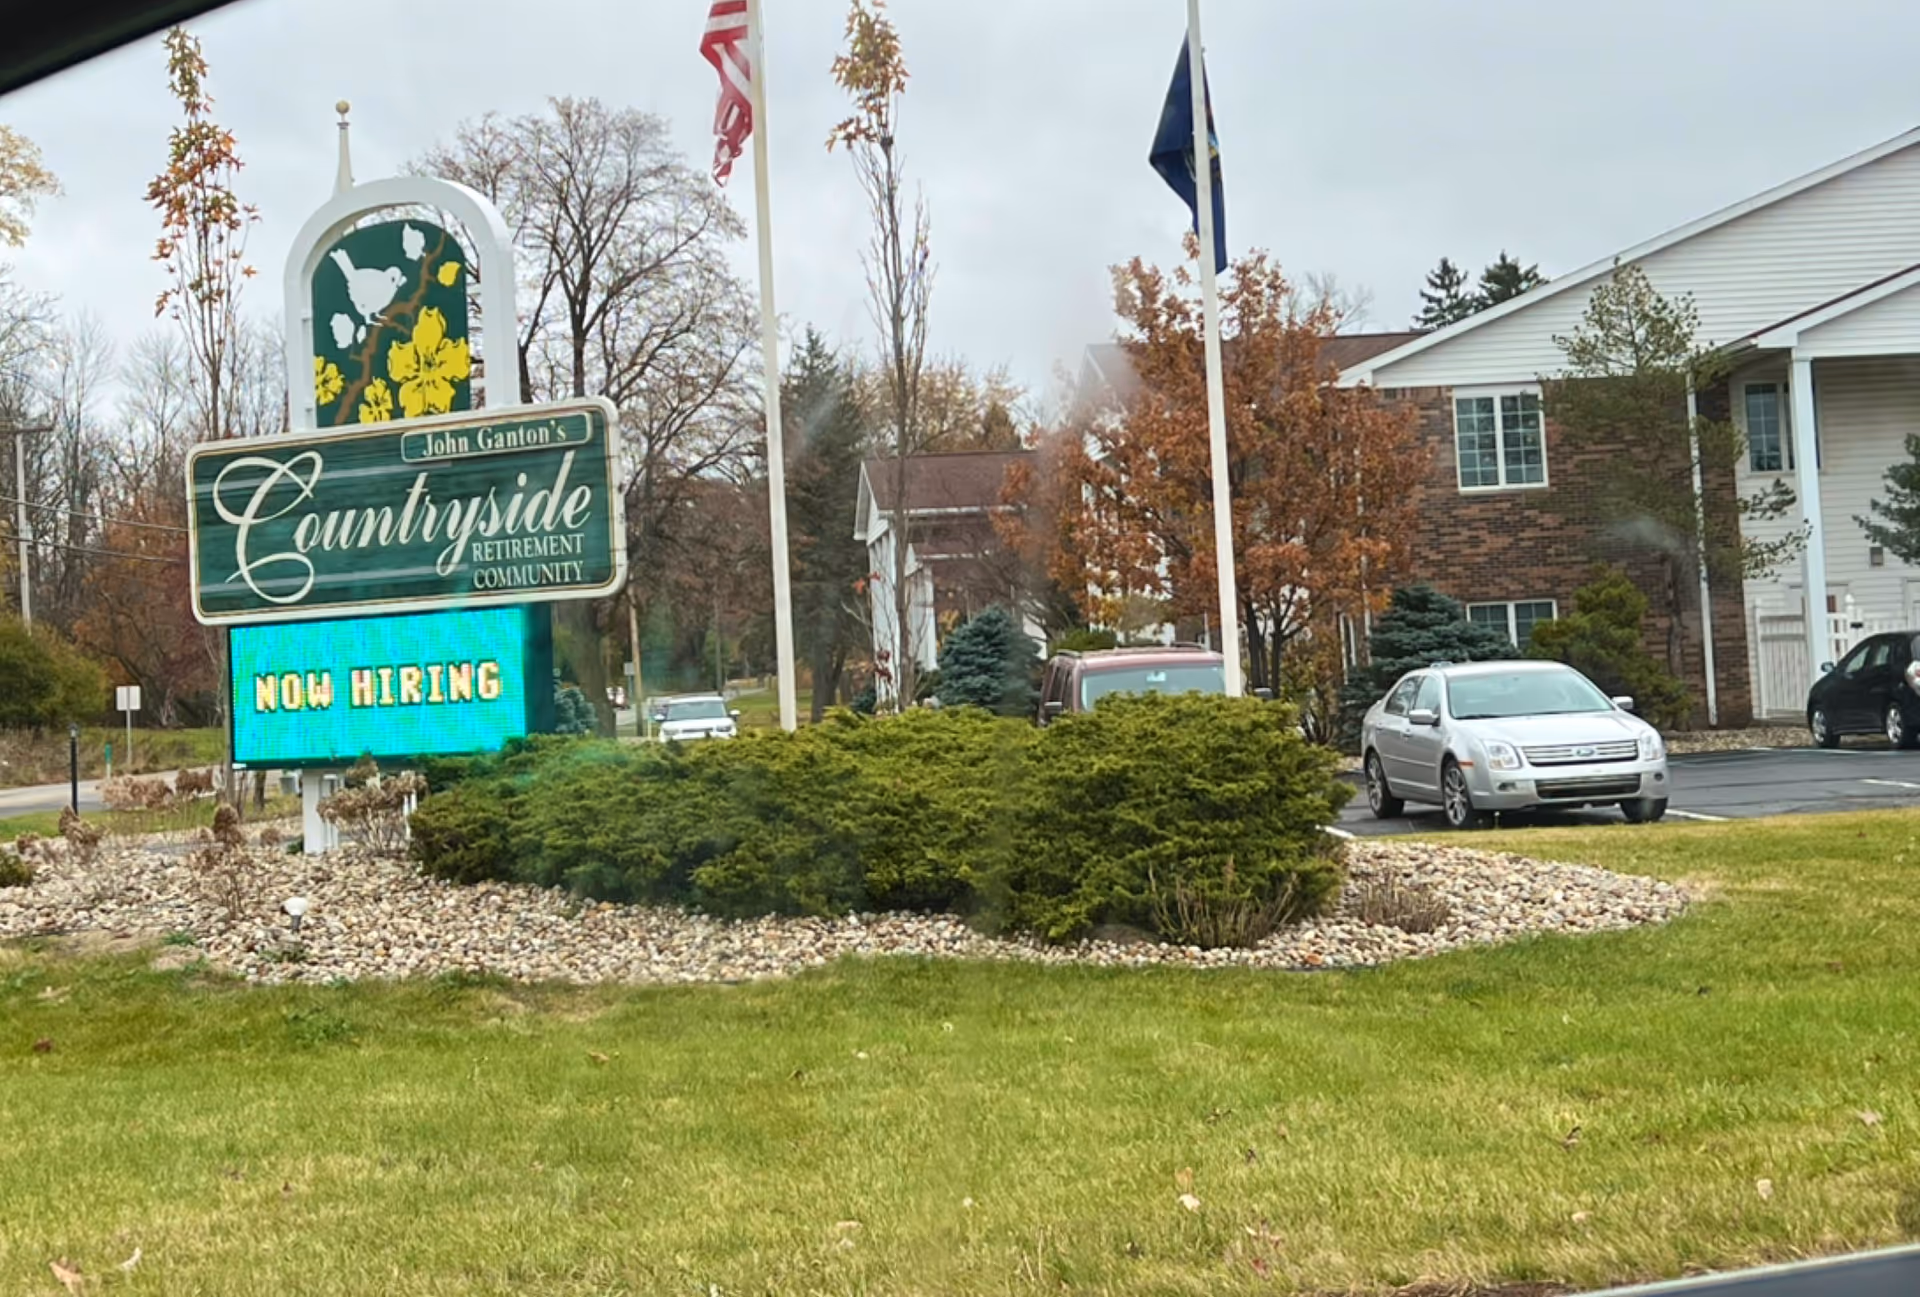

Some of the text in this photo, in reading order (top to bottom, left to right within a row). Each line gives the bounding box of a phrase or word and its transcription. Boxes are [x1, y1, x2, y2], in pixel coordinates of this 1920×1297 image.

[422, 419, 567, 457] John Ganton's
[212, 449, 592, 604] Countryside
[471, 532, 585, 562] RETIREMENT
[473, 560, 584, 589] COMMUNITY
[255, 661, 500, 712] NOW HIRING
